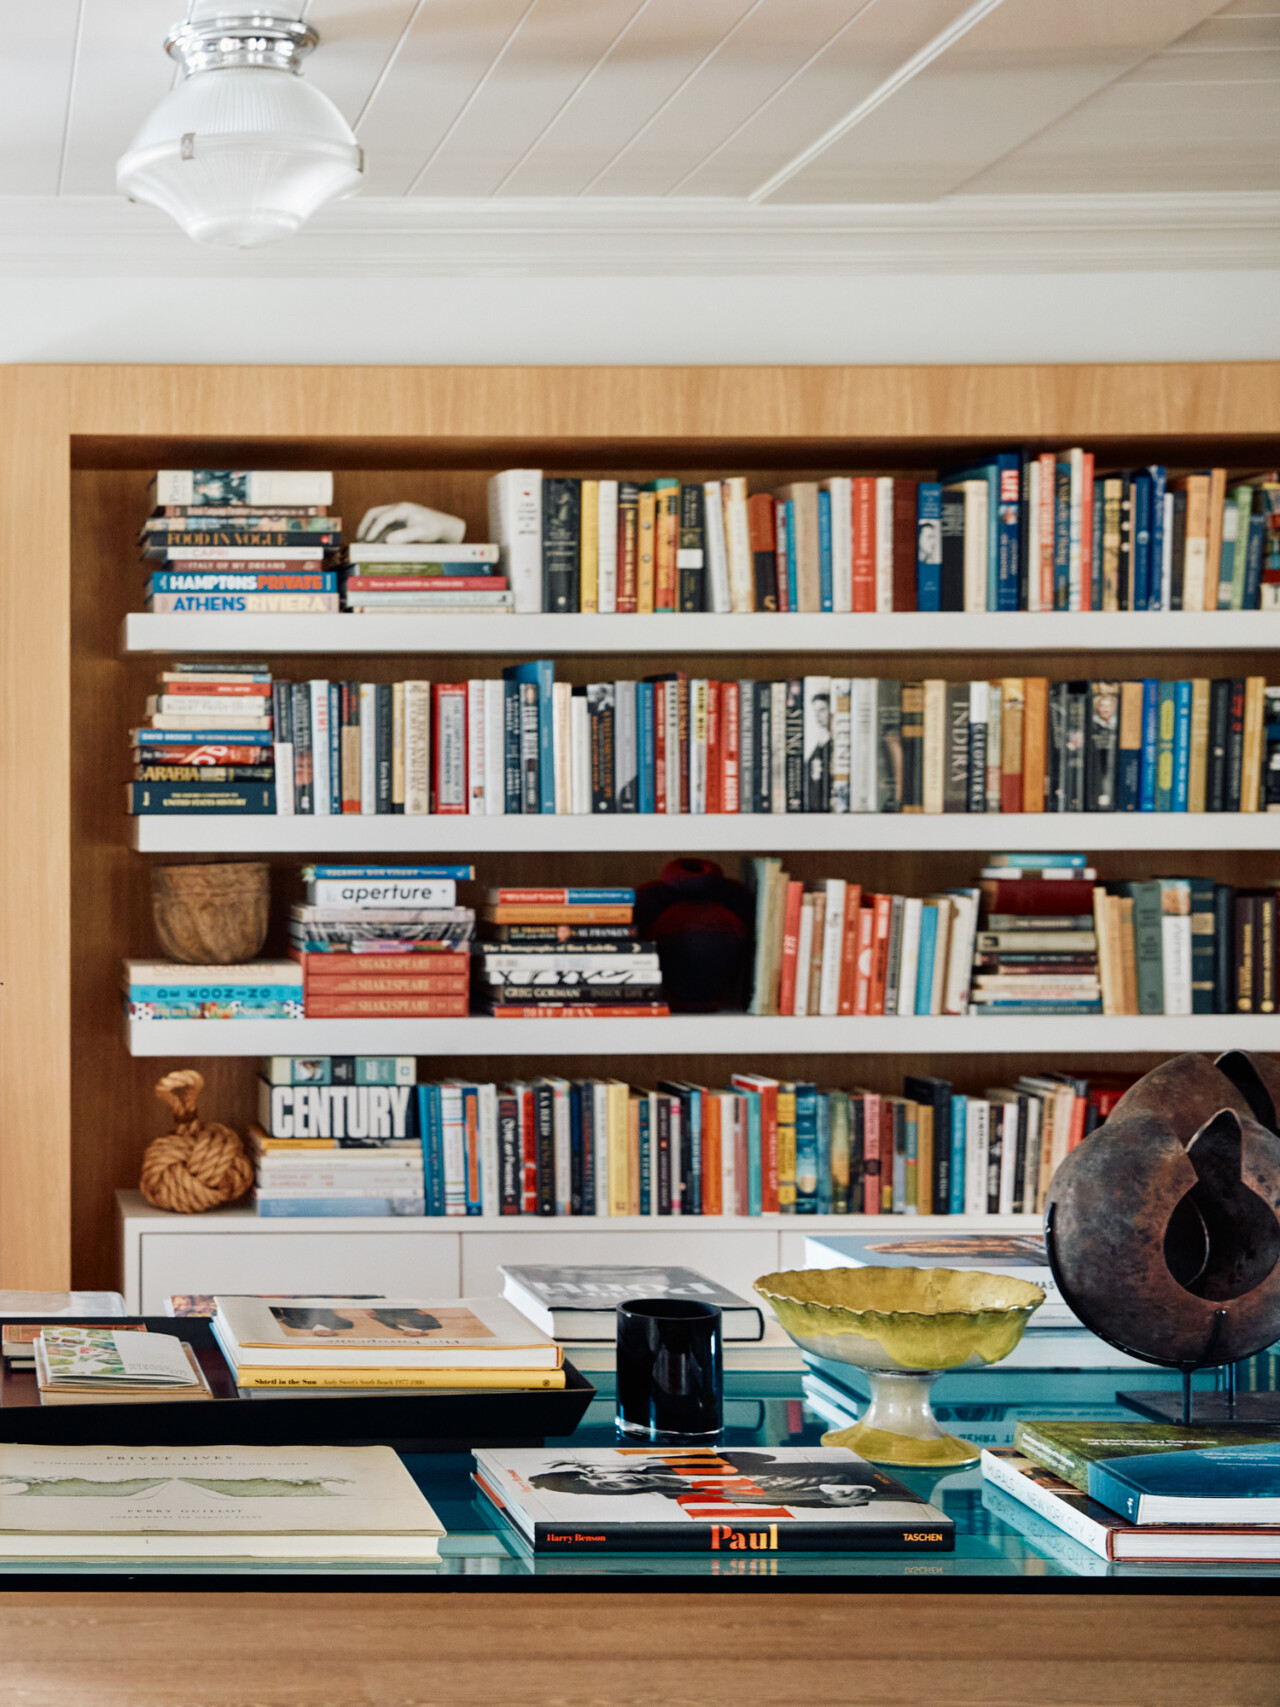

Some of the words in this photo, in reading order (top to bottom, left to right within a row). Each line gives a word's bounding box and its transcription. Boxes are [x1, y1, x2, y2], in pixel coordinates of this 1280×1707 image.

[1001, 470, 1018, 501] LIFE
[167, 533, 210, 546] FOOD
[213, 533, 230, 546] IN
[234, 533, 288, 546] VOGUE
[170, 575, 257, 590] HAMPTONS
[257, 575, 323, 590] PRIVATE
[174, 597, 246, 611] ATHENS
[247, 597, 326, 611] RIVIERA
[786, 709, 802, 755] STING
[952, 702, 968, 782] INDIRA
[972, 724, 984, 802] CLEOPATRA
[342, 884, 432, 902] aperture
[272, 1086, 411, 1138] CENTURY
[532, 1281, 716, 1295] Ponti
[546, 1533, 574, 1544] Harry
[574, 1533, 607, 1542] Benson
[710, 1523, 780, 1550] Paul
[903, 1533, 943, 1542] TASCHEN
